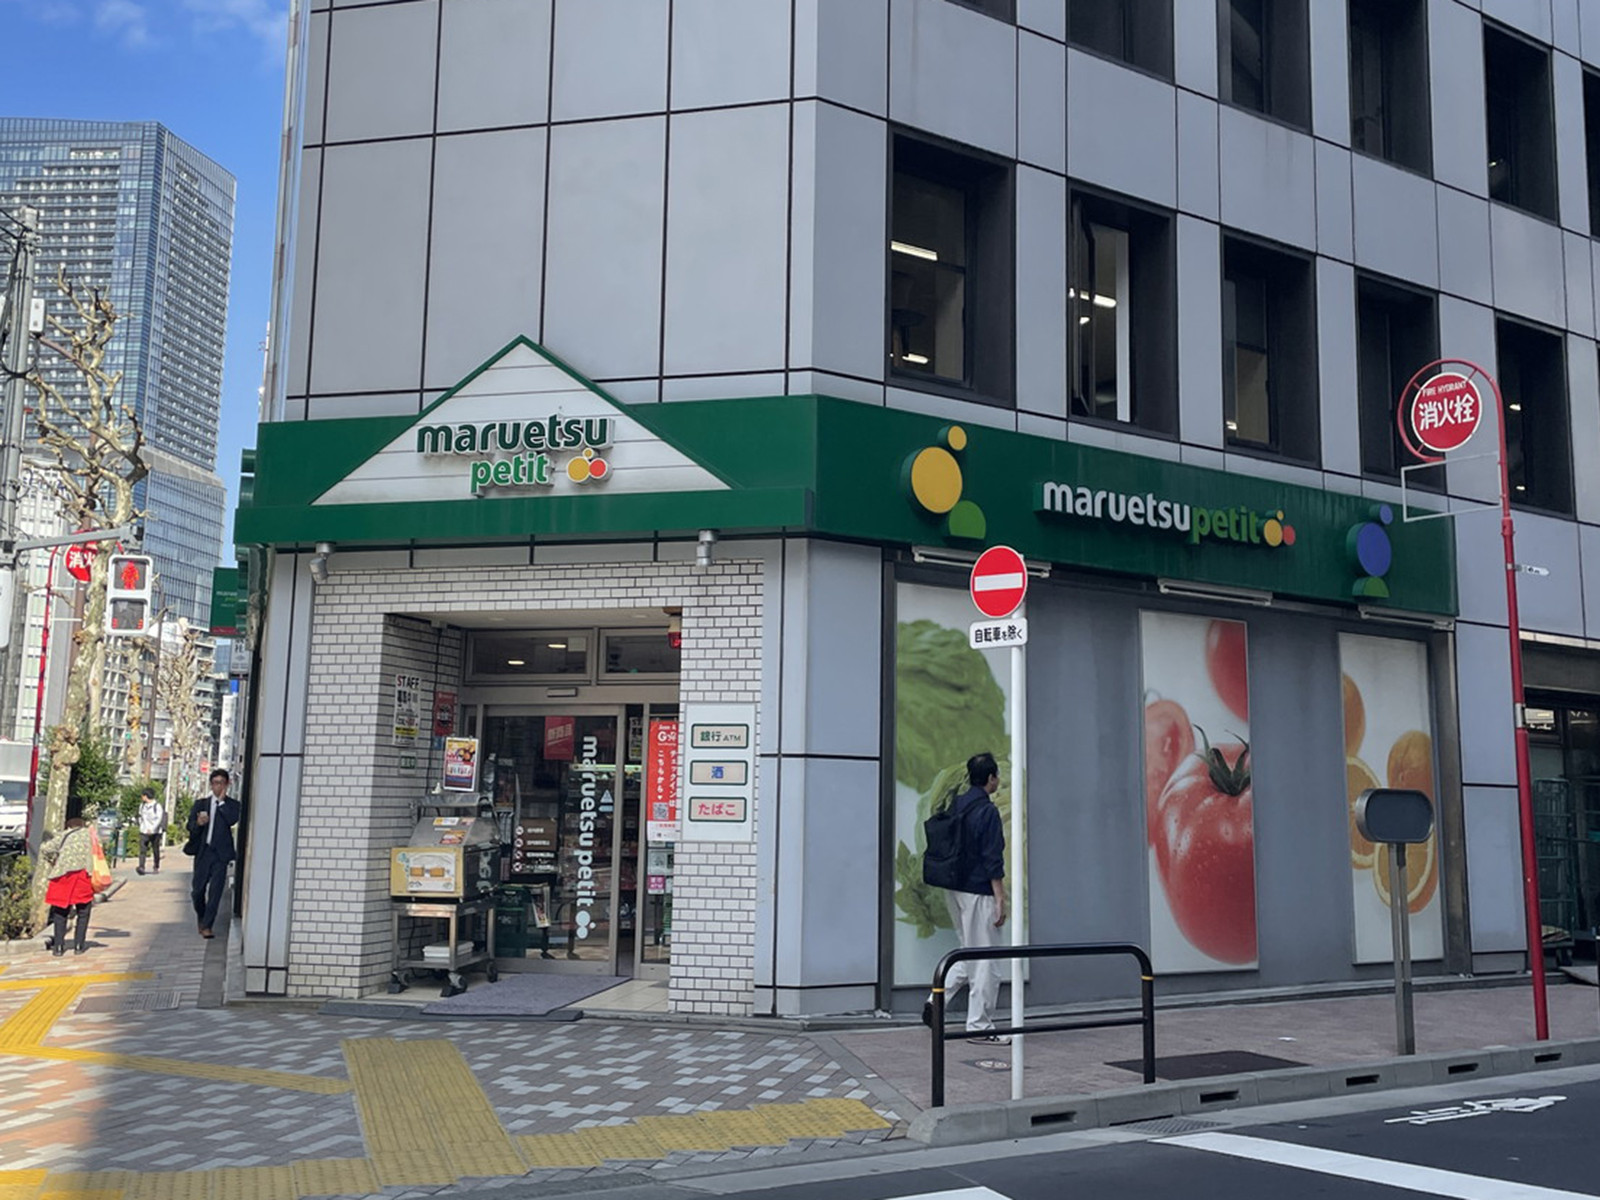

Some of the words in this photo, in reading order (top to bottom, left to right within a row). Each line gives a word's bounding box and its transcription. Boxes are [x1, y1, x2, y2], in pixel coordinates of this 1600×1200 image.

[1437, 380, 1468, 395] HYDRANT
[1418, 392, 1476, 431] 消火栓
[416, 413, 610, 454] maruetsu
[469, 451, 551, 495] petit
[69, 550, 96, 568] 消火
[974, 624, 1023, 643] 自転車を除く
[396, 675, 420, 689] STAFF
[699, 730, 722, 742] 銀行
[722, 734, 742, 742] ATM
[711, 765, 725, 779] 酒
[697, 802, 736, 816] たばこ
